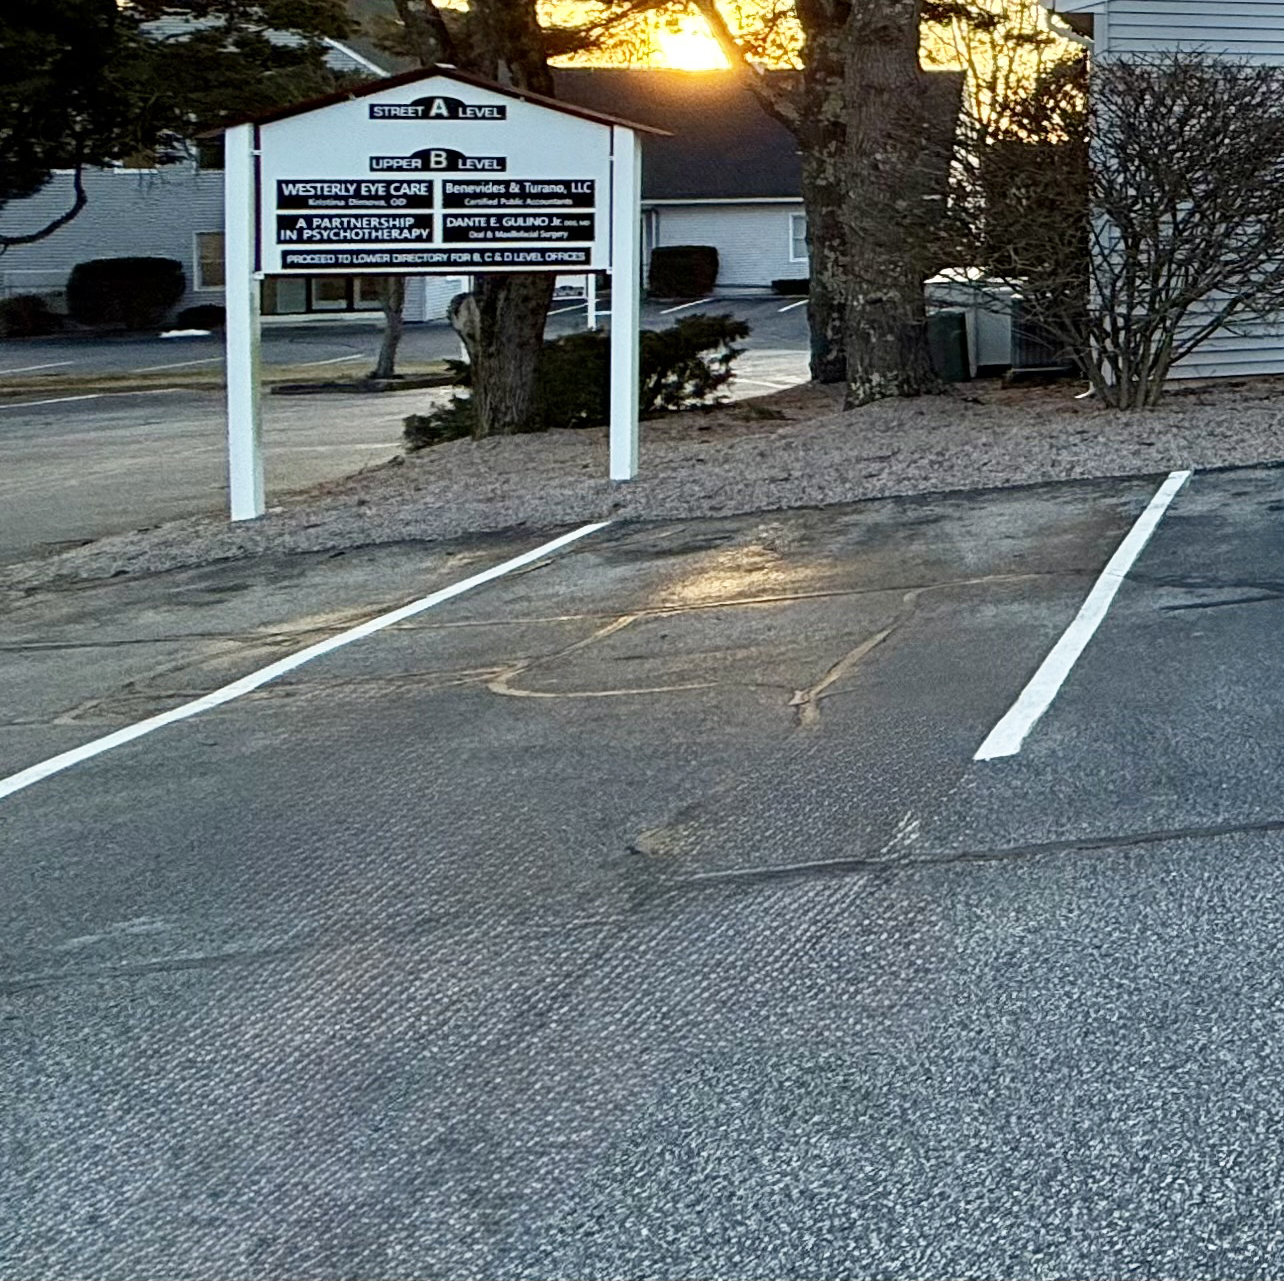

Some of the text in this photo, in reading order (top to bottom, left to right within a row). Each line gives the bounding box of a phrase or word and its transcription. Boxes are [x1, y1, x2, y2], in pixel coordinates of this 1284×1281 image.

[373, 98, 502, 118] STREET A LEVEL
[372, 150, 502, 169] UPPER B LEVEL
[281, 183, 429, 196] WESTERLY EYE CARE
[445, 181, 592, 194] Benevides & Turano, LLC
[308, 198, 346, 206] Kristina
[390, 198, 407, 206] OD
[464, 198, 498, 206] Certified
[295, 217, 415, 229] A PARTNERSHIP
[446, 217, 487, 227] DANTE
[502, 217, 549, 227] GULINO
[280, 228, 430, 240] IN PSYCHOTHERAPY
[286, 254, 336, 264] PROCEED
[337, 254, 351, 263] TO
[353, 254, 390, 263] LOWER
[392, 253, 449, 263] DIRECTORY
[451, 253, 471, 262] FOR
[484, 253, 493, 261] C
[494, 252, 502, 261] &
[504, 252, 512, 261] D
[514, 252, 544, 261] LEVEL
[545, 252, 586, 261] OFFICES
